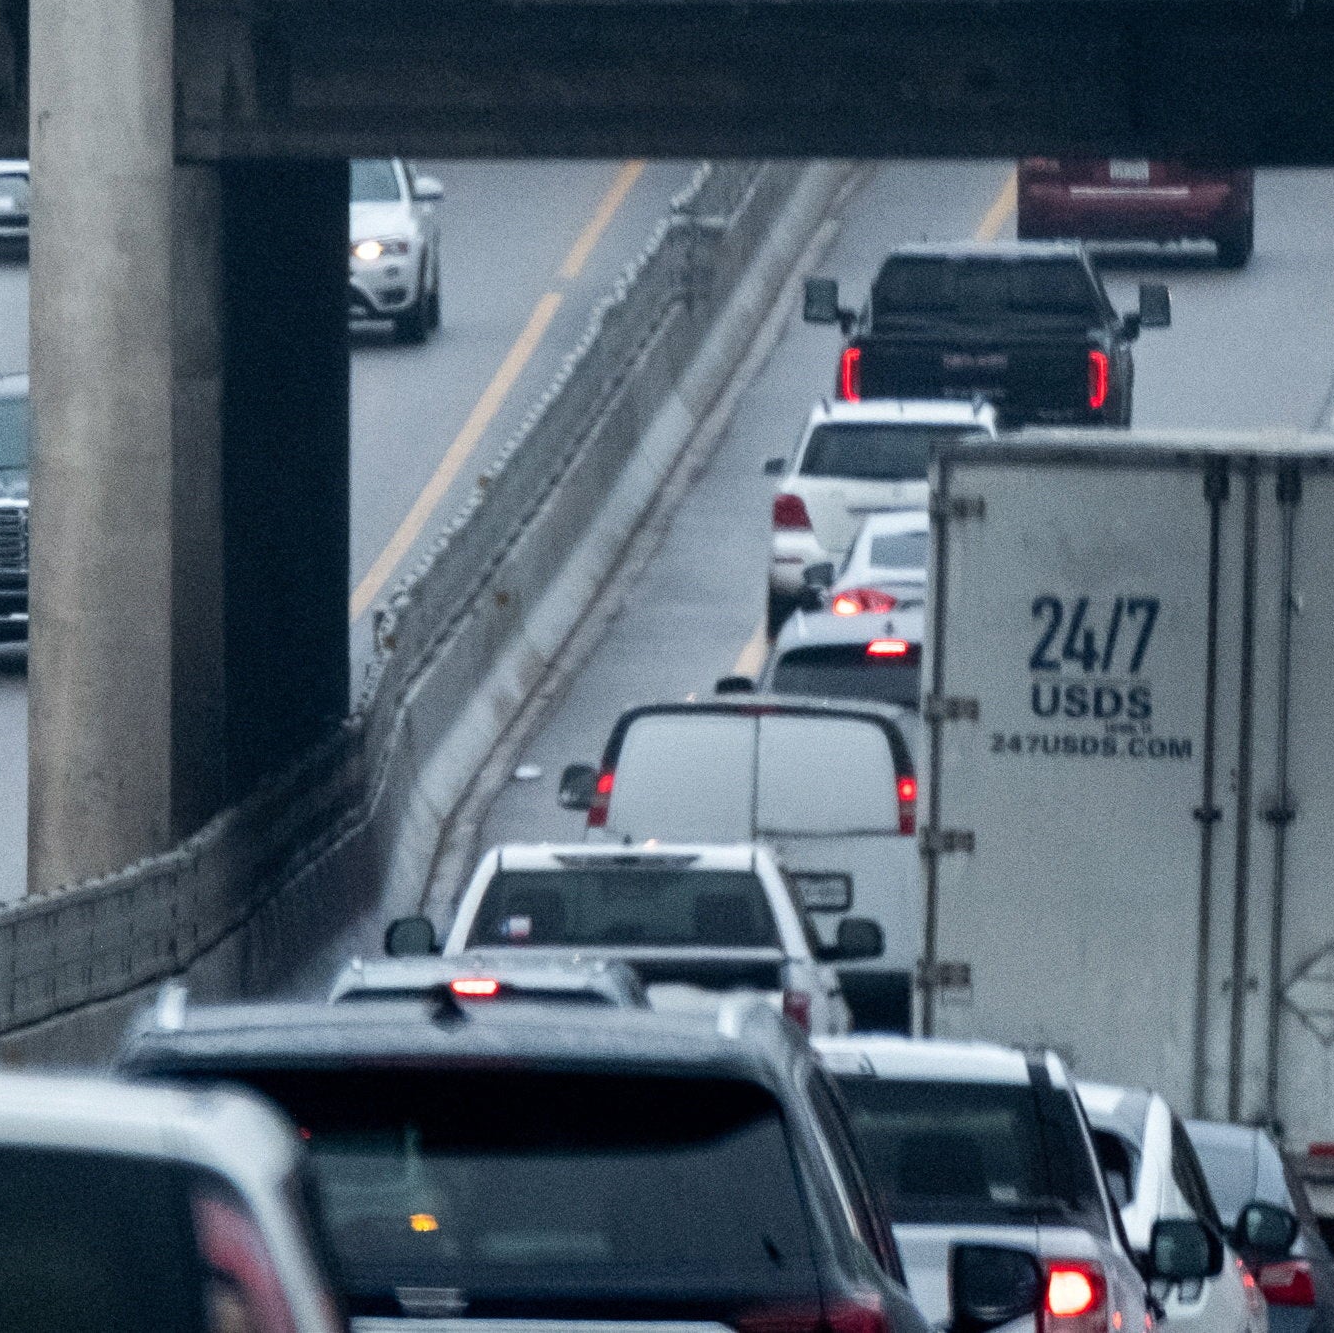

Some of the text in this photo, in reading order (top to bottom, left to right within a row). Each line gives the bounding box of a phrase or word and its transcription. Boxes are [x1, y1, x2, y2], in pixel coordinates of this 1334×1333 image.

[1030, 597, 1160, 673] 24/7
[1032, 685, 1151, 720] USDS
[993, 732, 1192, 760] 247USDS.COM
